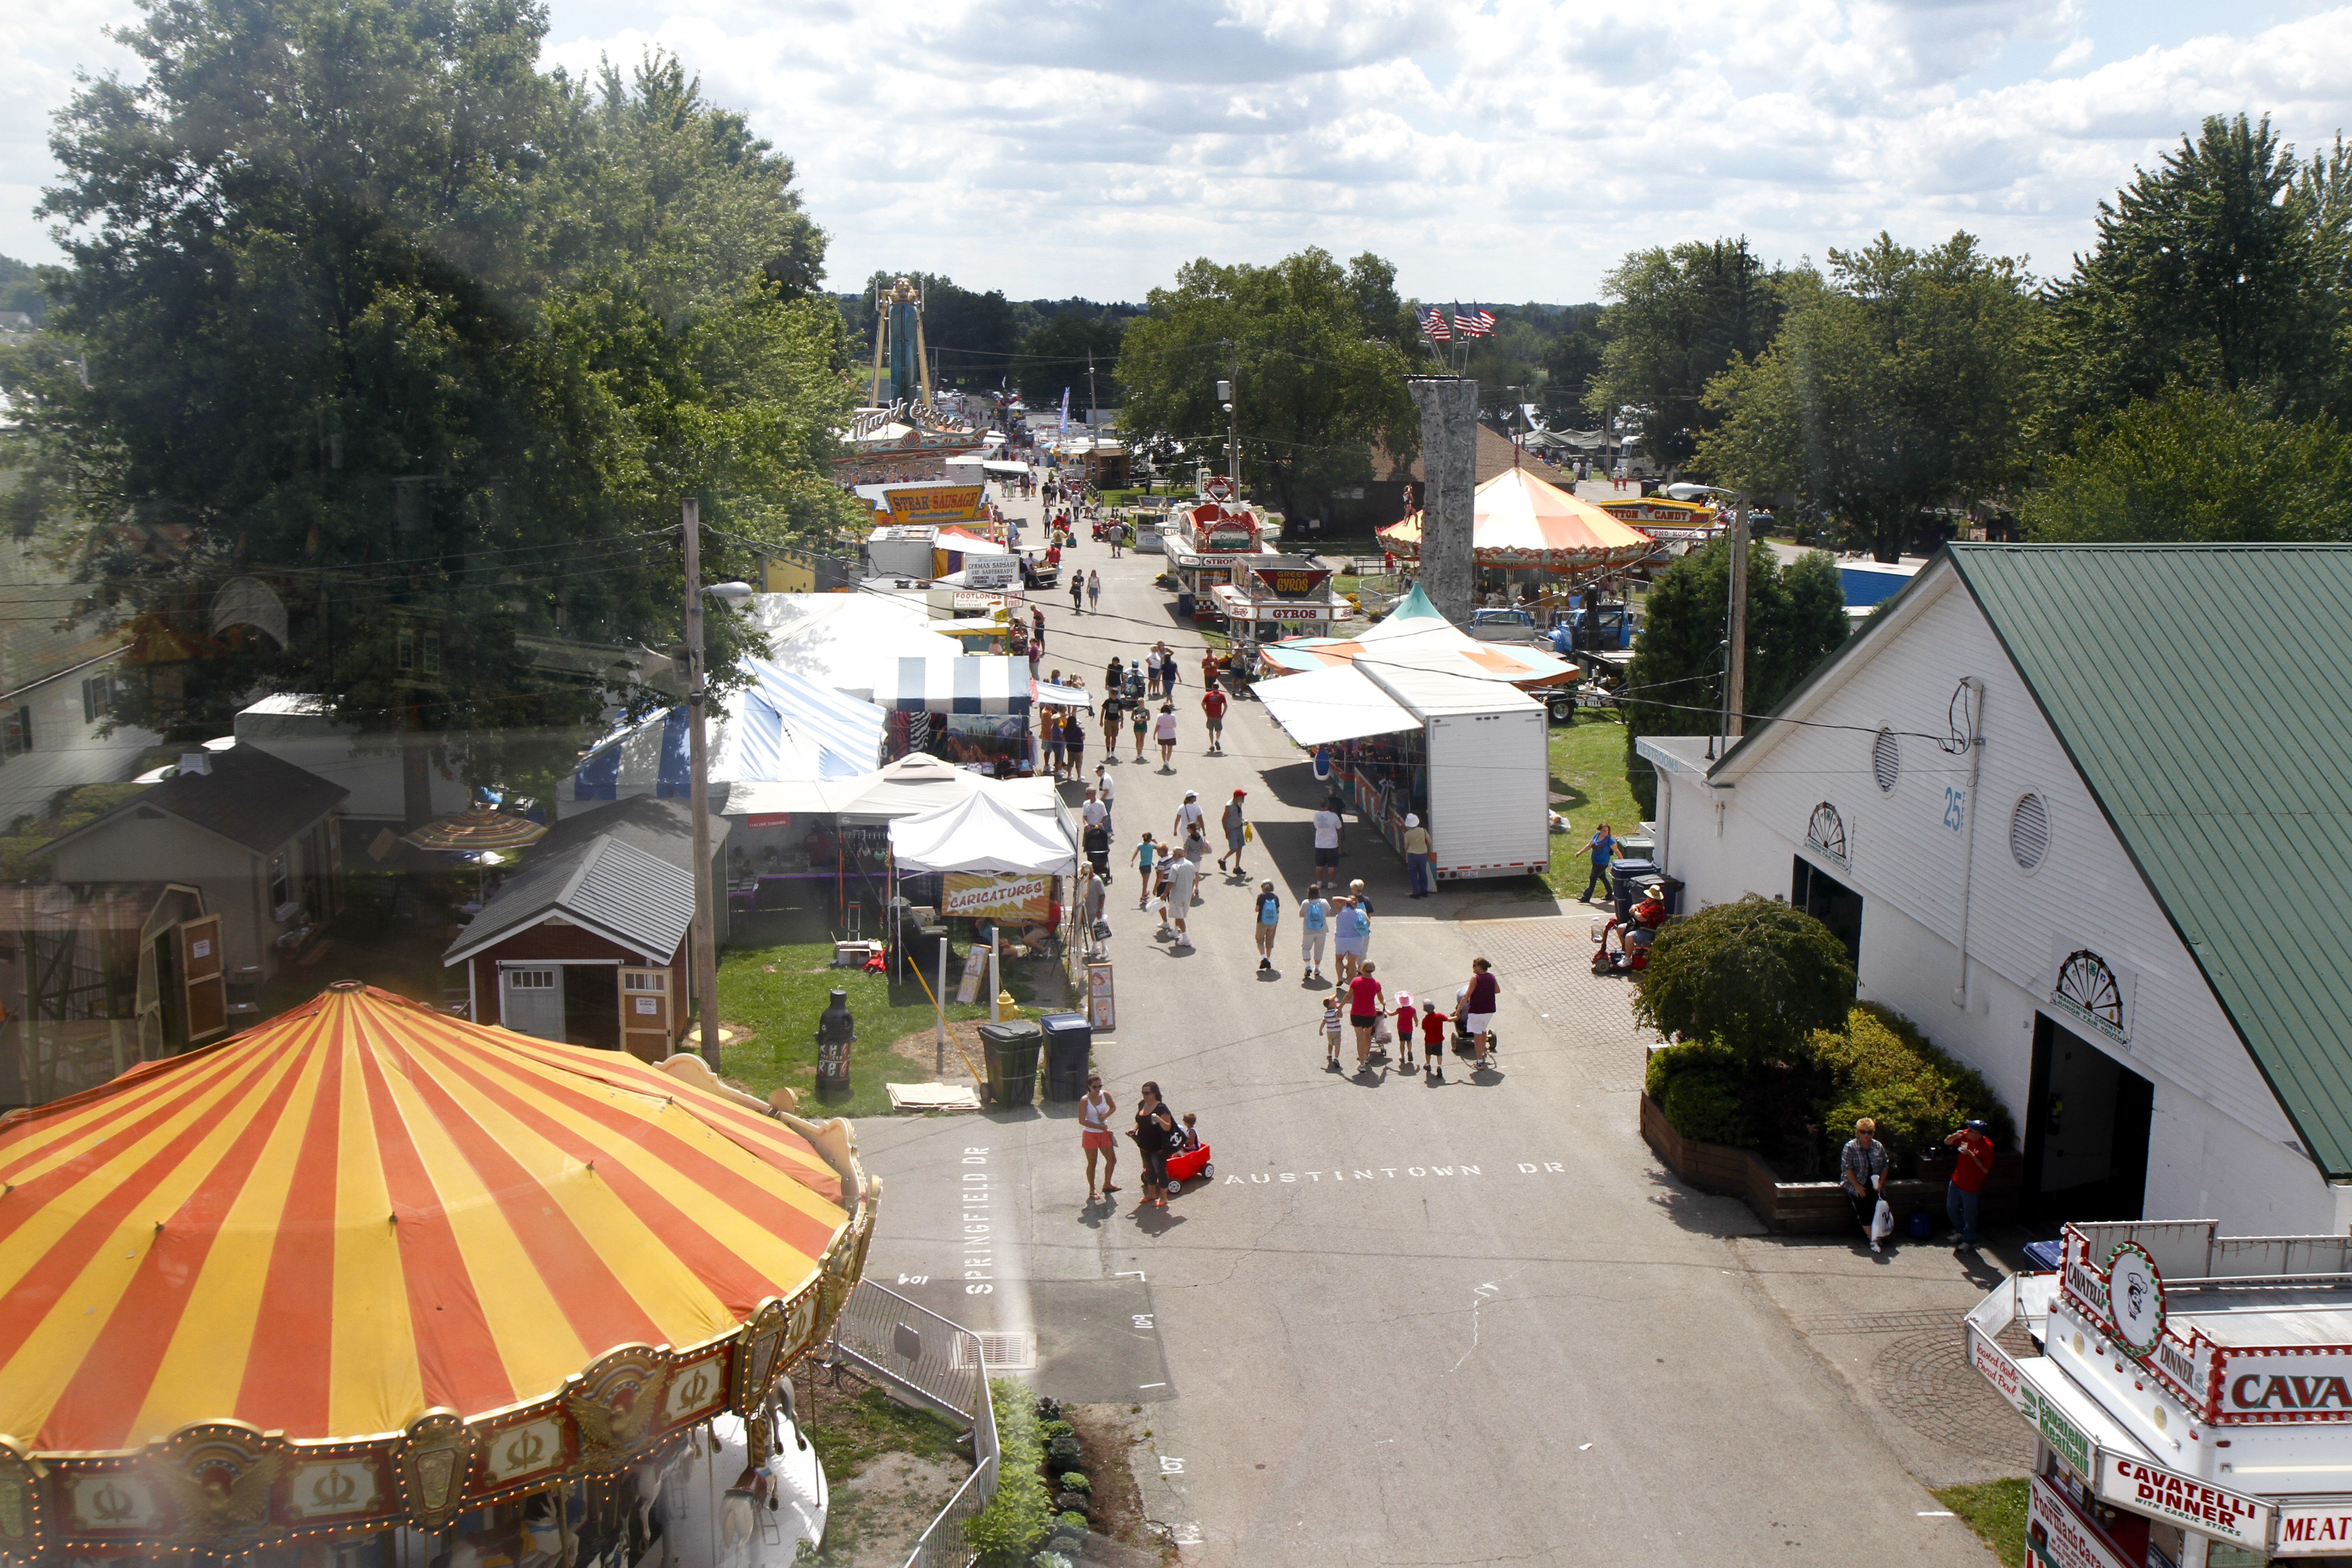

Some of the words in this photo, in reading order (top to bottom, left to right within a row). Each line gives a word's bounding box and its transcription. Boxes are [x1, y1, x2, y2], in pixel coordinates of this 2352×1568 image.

[909, 398, 963, 432] Express
[893, 496, 930, 511] STEAK
[932, 492, 978, 509] SAUSAGE
[1606, 509, 1638, 519] OTTON
[1654, 511, 1688, 520] CANDY
[1277, 578, 1308, 592] GYROS
[1273, 609, 1317, 618] GYROS
[1944, 787, 1961, 831] 25
[950, 882, 1042, 908] CARICATURES
[2057, 994, 2092, 1017] MAHONING
[2094, 1016, 2122, 1035] COUNTY
[2057, 1000, 2080, 1016] JUNIOR
[2083, 1015, 2098, 1027] FAIR
[2101, 1025, 2122, 1042] YOUTH
[961, 1147, 990, 1164] DR
[1225, 1165, 1481, 1185] AUSTINTOWN
[1517, 1162, 1565, 1173] DR
[962, 1173, 993, 1294] SPRINGFIELD
[1132, 1314, 1154, 1328] 109
[2068, 1262, 2105, 1311] CAVATELLI
[2160, 1343, 2195, 1390] DINNER
[1976, 1341, 1998, 1368] Toasted
[1999, 1361, 2019, 1384] Garlic
[1976, 1357, 1997, 1382] Bread
[1998, 1374, 2017, 1397] Bowl
[2021, 1385, 2036, 1408] with
[2038, 1395, 2087, 1458] Cavatelli
[2040, 1413, 2088, 1478] Meatball
[2117, 1460, 2255, 1519] CAVATELLI
[2138, 1483, 2235, 1529] DINNER
[2032, 1483, 2078, 1551] Poorman's
[2135, 1497, 2160, 1509] WITH
[2164, 1507, 2200, 1523] GARLIC
[2205, 1520, 2241, 1537] STICKS
